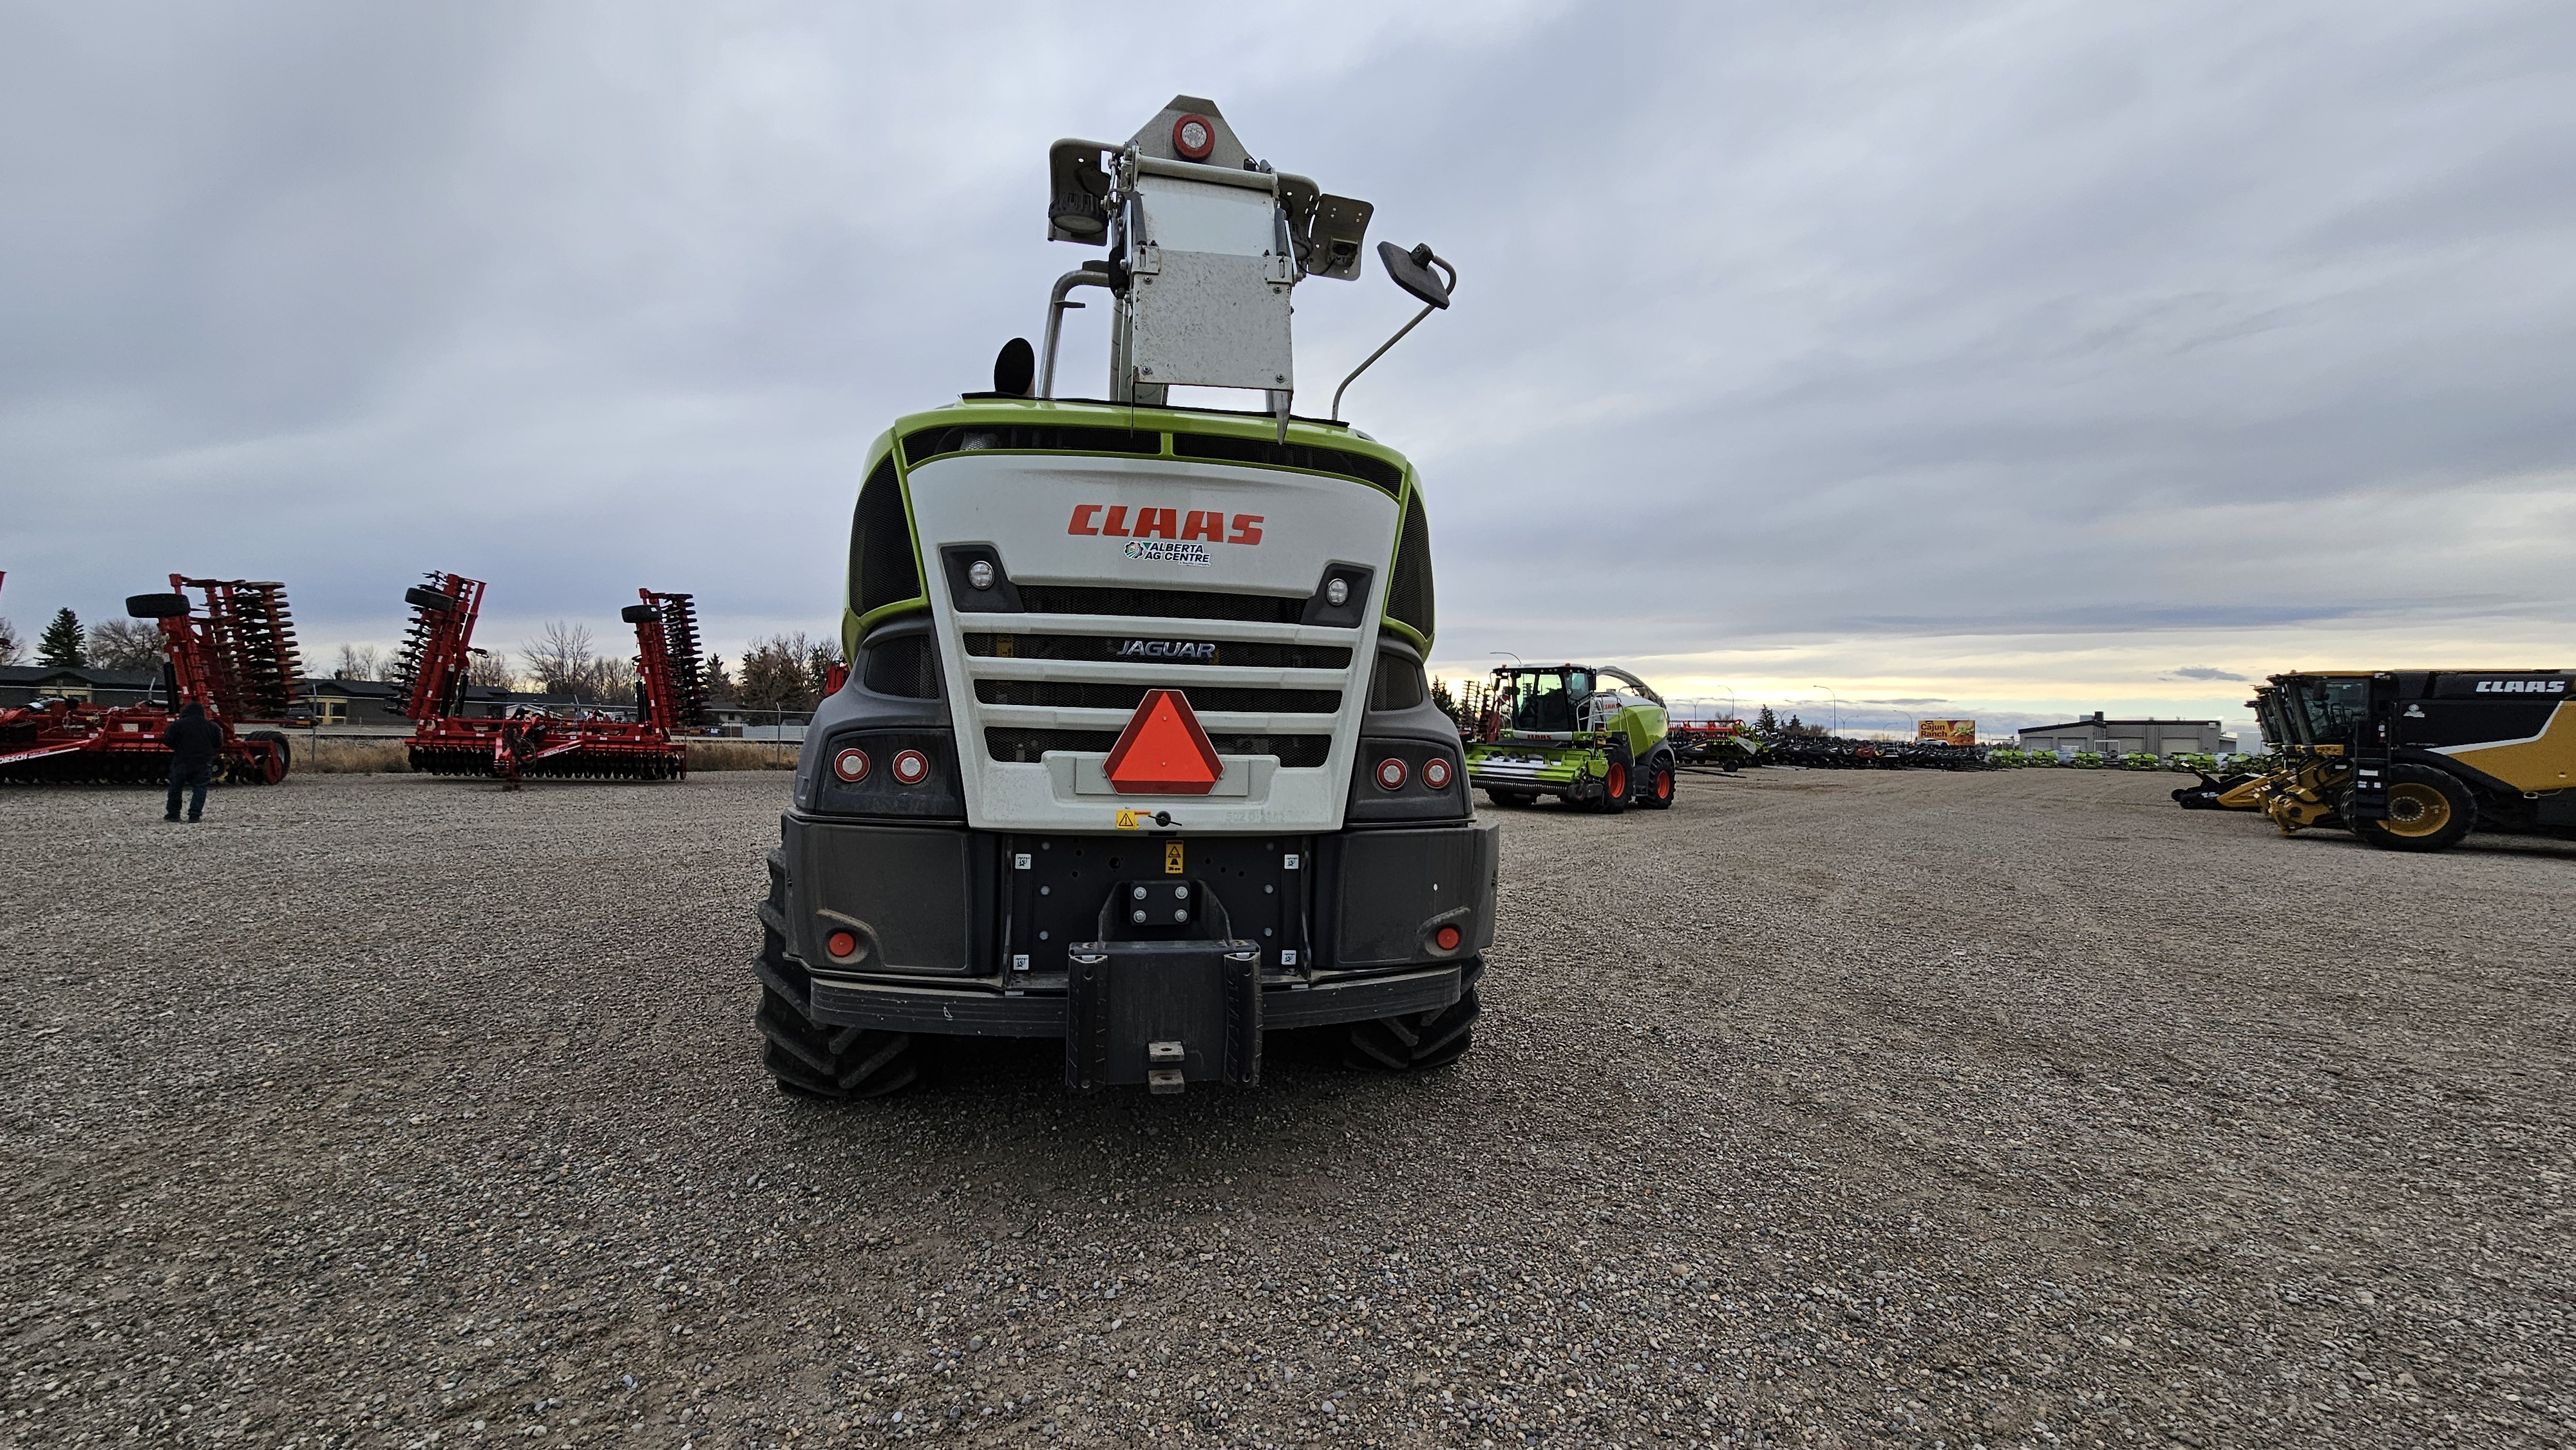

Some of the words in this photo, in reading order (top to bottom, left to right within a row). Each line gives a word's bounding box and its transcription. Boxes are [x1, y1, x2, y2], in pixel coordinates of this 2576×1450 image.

[1067, 504, 1265, 546] CLAAS
[1150, 543, 1204, 554] ALBERTA
[1144, 552, 1161, 560] AG
[1165, 552, 1210, 562] CENTRE
[1117, 640, 1216, 659] JAGUAR
[2476, 681, 2566, 693] CLAAS
[1920, 723, 1946, 731] Cajun
